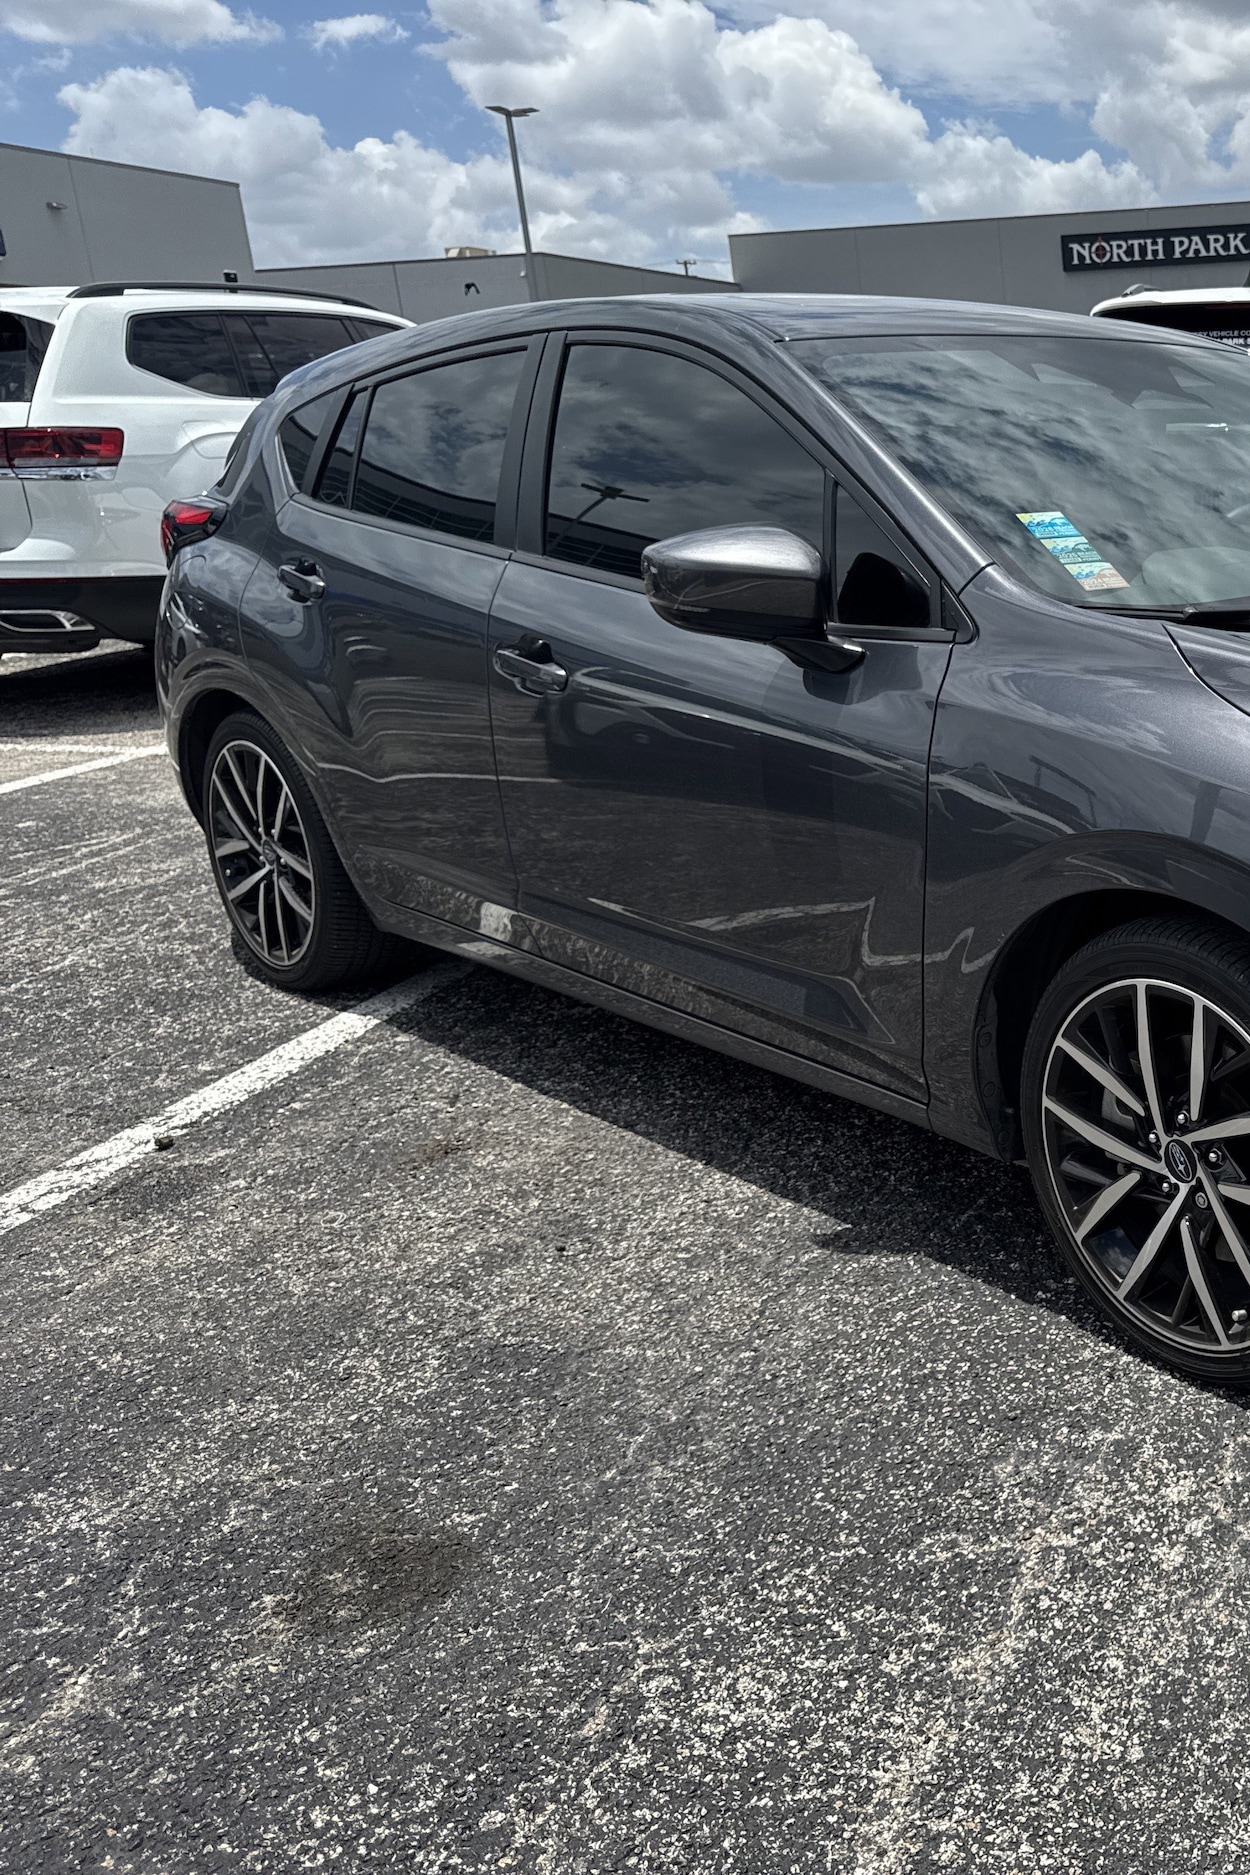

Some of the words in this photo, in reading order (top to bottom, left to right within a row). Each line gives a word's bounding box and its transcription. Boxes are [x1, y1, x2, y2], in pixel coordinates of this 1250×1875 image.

[1069, 237, 1165, 266] NORTH
[1170, 232, 1250, 259] PARK
[1209, 330, 1239, 338] VEHICLE
